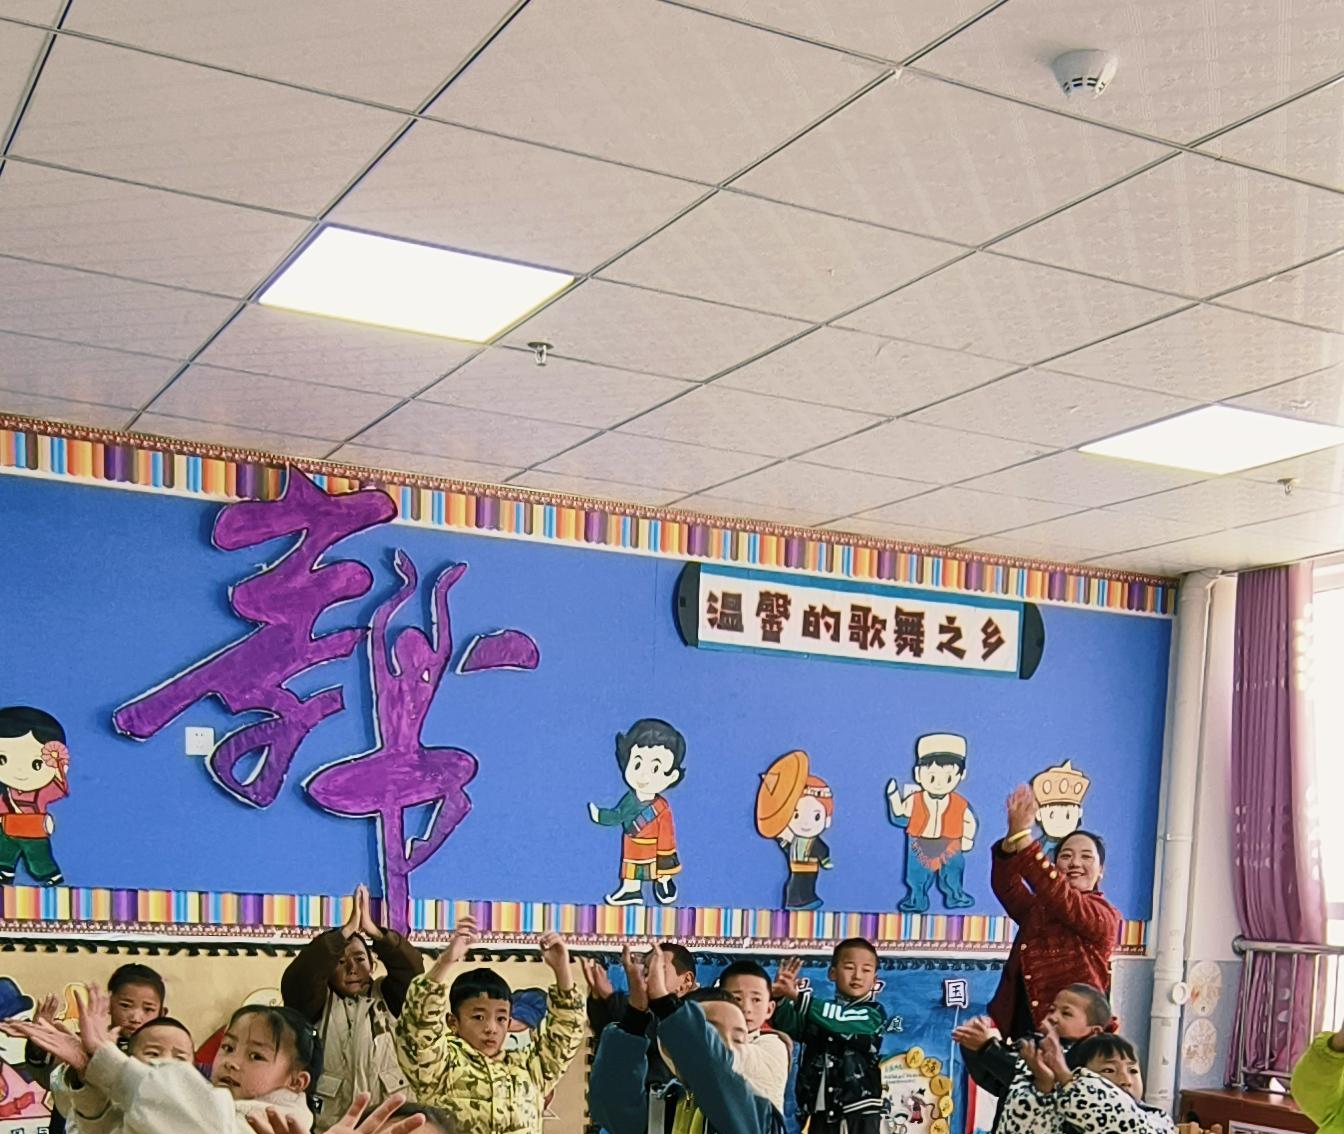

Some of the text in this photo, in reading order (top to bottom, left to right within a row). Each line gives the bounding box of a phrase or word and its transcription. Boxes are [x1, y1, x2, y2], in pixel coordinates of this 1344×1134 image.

[706, 589, 1006, 662] 温馨的歌舞之乡
